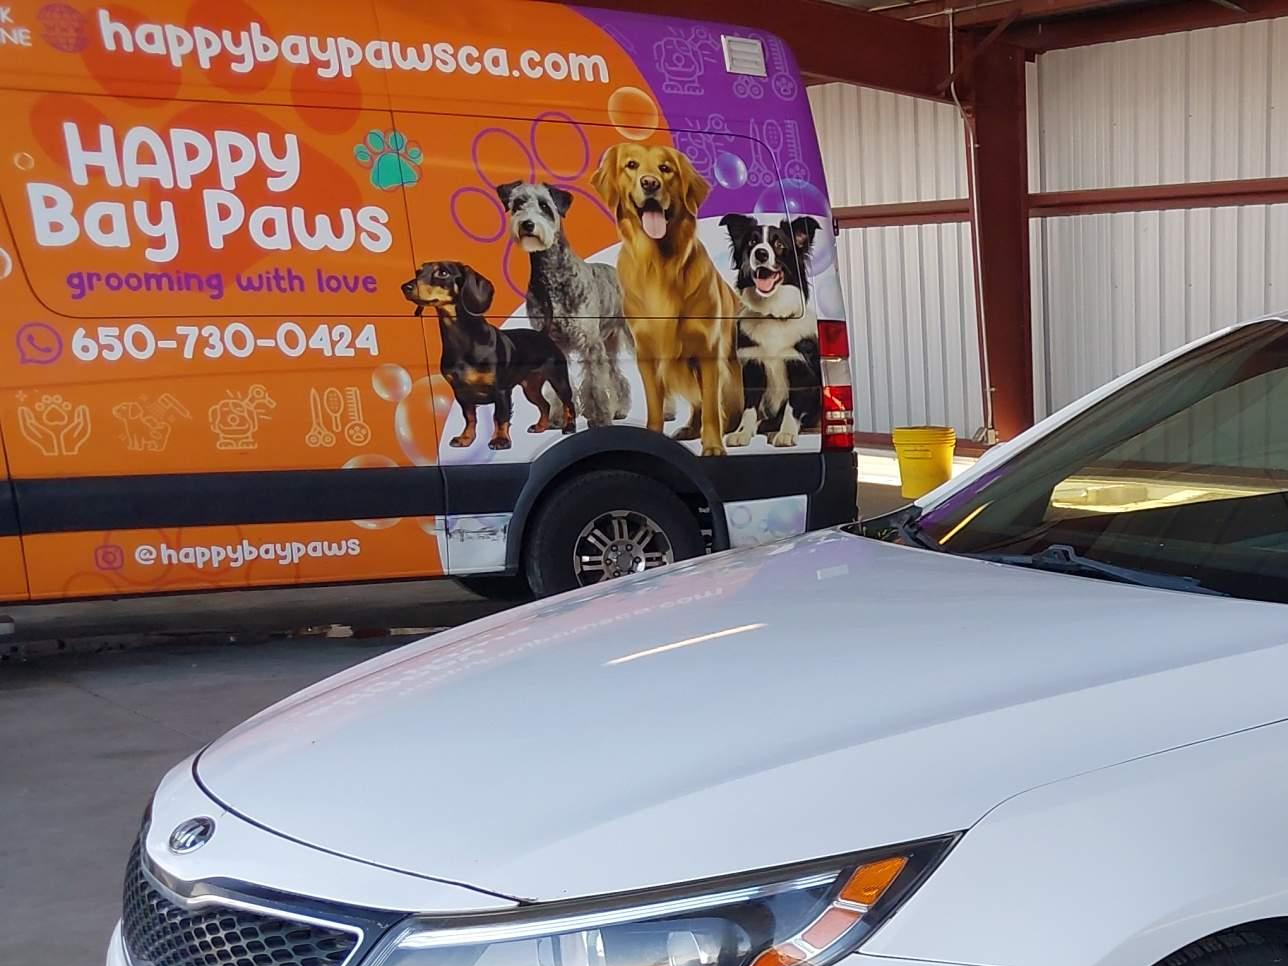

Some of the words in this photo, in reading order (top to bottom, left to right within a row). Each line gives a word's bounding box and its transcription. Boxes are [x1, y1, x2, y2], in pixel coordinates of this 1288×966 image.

[99, 8, 610, 83] happybaypawsca.com
[63, 121, 301, 193] HAPPY
[27, 182, 180, 263] Bay
[203, 189, 393, 253] Paws
[66, 269, 224, 299] grooming
[236, 268, 305, 293] with
[317, 268, 378, 293] love
[71, 322, 379, 361] 650-730-0424
[135, 538, 361, 568] @happybaypaws
